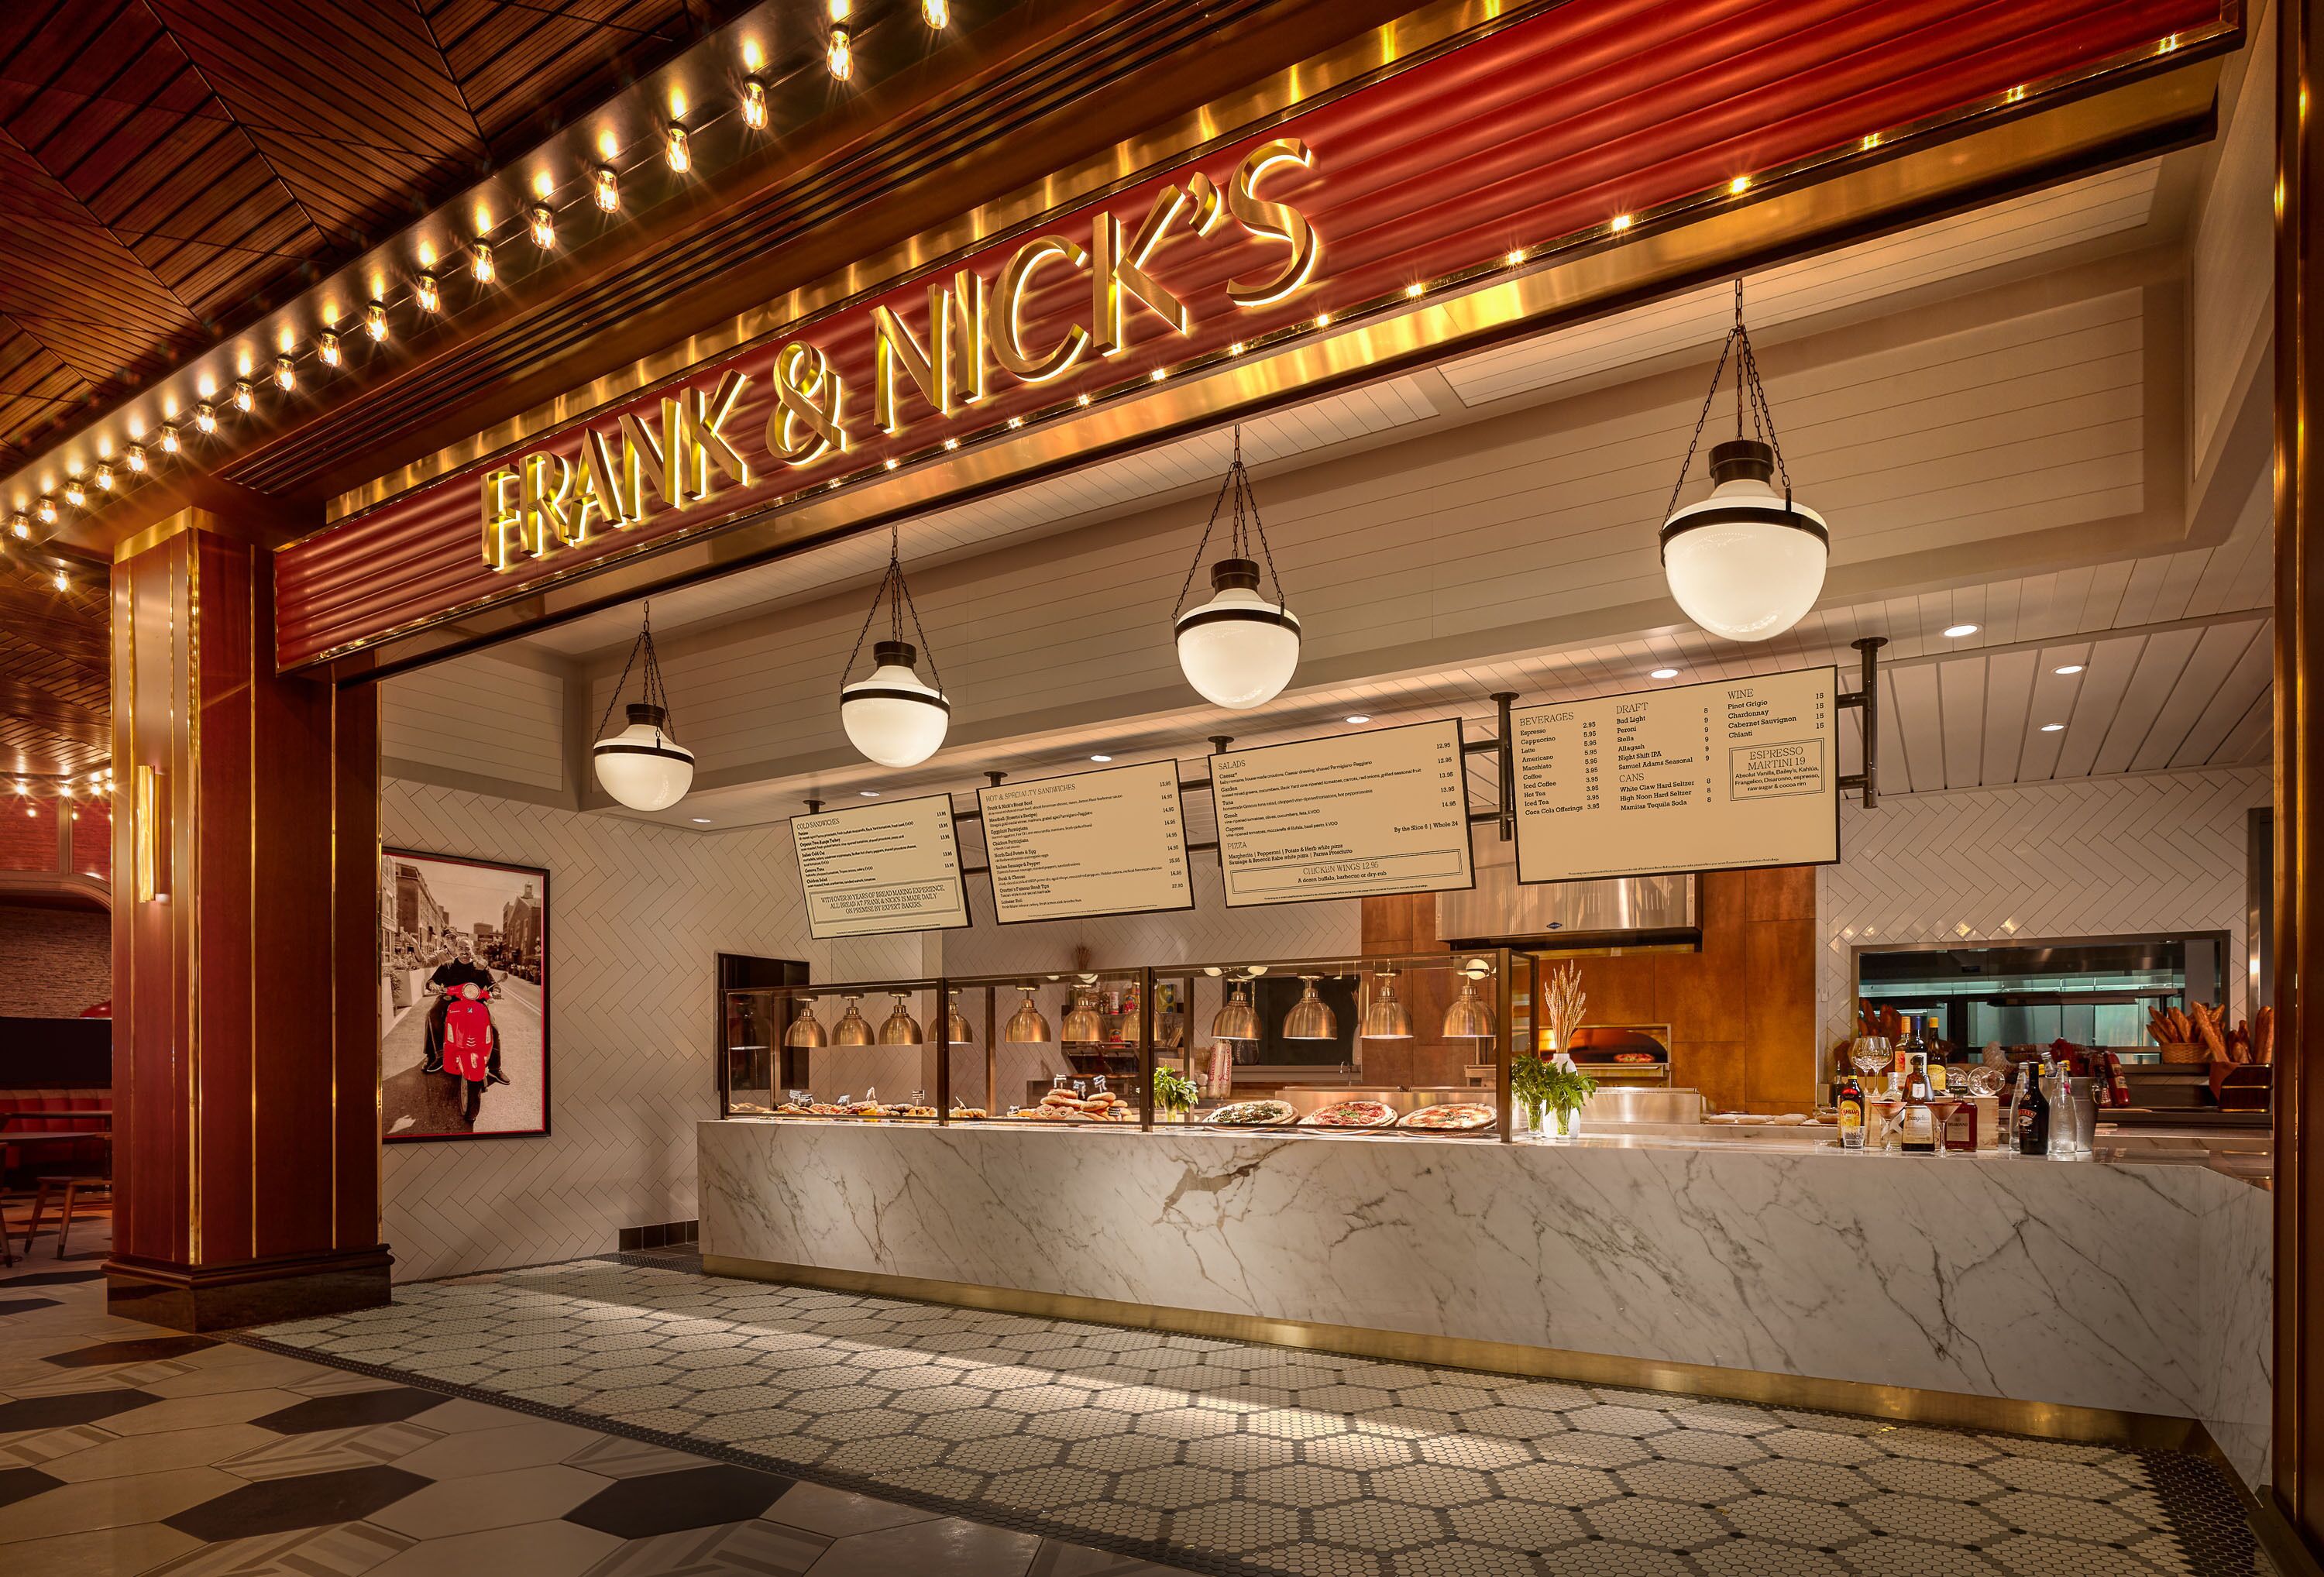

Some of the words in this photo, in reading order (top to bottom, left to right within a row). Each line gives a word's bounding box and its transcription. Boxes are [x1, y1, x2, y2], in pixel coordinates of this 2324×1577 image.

[481, 369, 748, 572] FRANK
[766, 339, 847, 466] &
[872, 137, 1317, 434] NICK'S
[1727, 688, 1753, 699] WINE
[1615, 702, 1648, 714] DRAFT
[1519, 711, 1573, 726] BEVERAGES
[1728, 709, 1769, 719] Chardonnay
[1728, 720, 1759, 728] Cabernet
[1760, 716, 1796, 724] Sauvignon
[1520, 728, 1545, 737] Espresso
[1616, 725, 1636, 734] Peroni
[1728, 730, 1752, 738] Chianti
[1520, 736, 1556, 745] Cappuccino
[1618, 743, 1645, 751] Allagash
[1749, 745, 1803, 760] ESPRESSO
[1218, 759, 1246, 770] SALADS
[1618, 761, 1641, 770] Samuel
[1664, 756, 1693, 764] Seasonal
[1748, 758, 1792, 770] MARTINI
[1795, 756, 1805, 765] 19
[1618, 772, 1644, 782] CANS
[1004, 788, 1037, 799] SPECIALTY
[1037, 782, 1075, 795] SANDWICHES
[1226, 841, 1246, 850] PIZZA
[1302, 865, 1335, 874] CHICKEN
[1336, 861, 1360, 871] WINGS
[1362, 861, 1378, 869] 12.95
